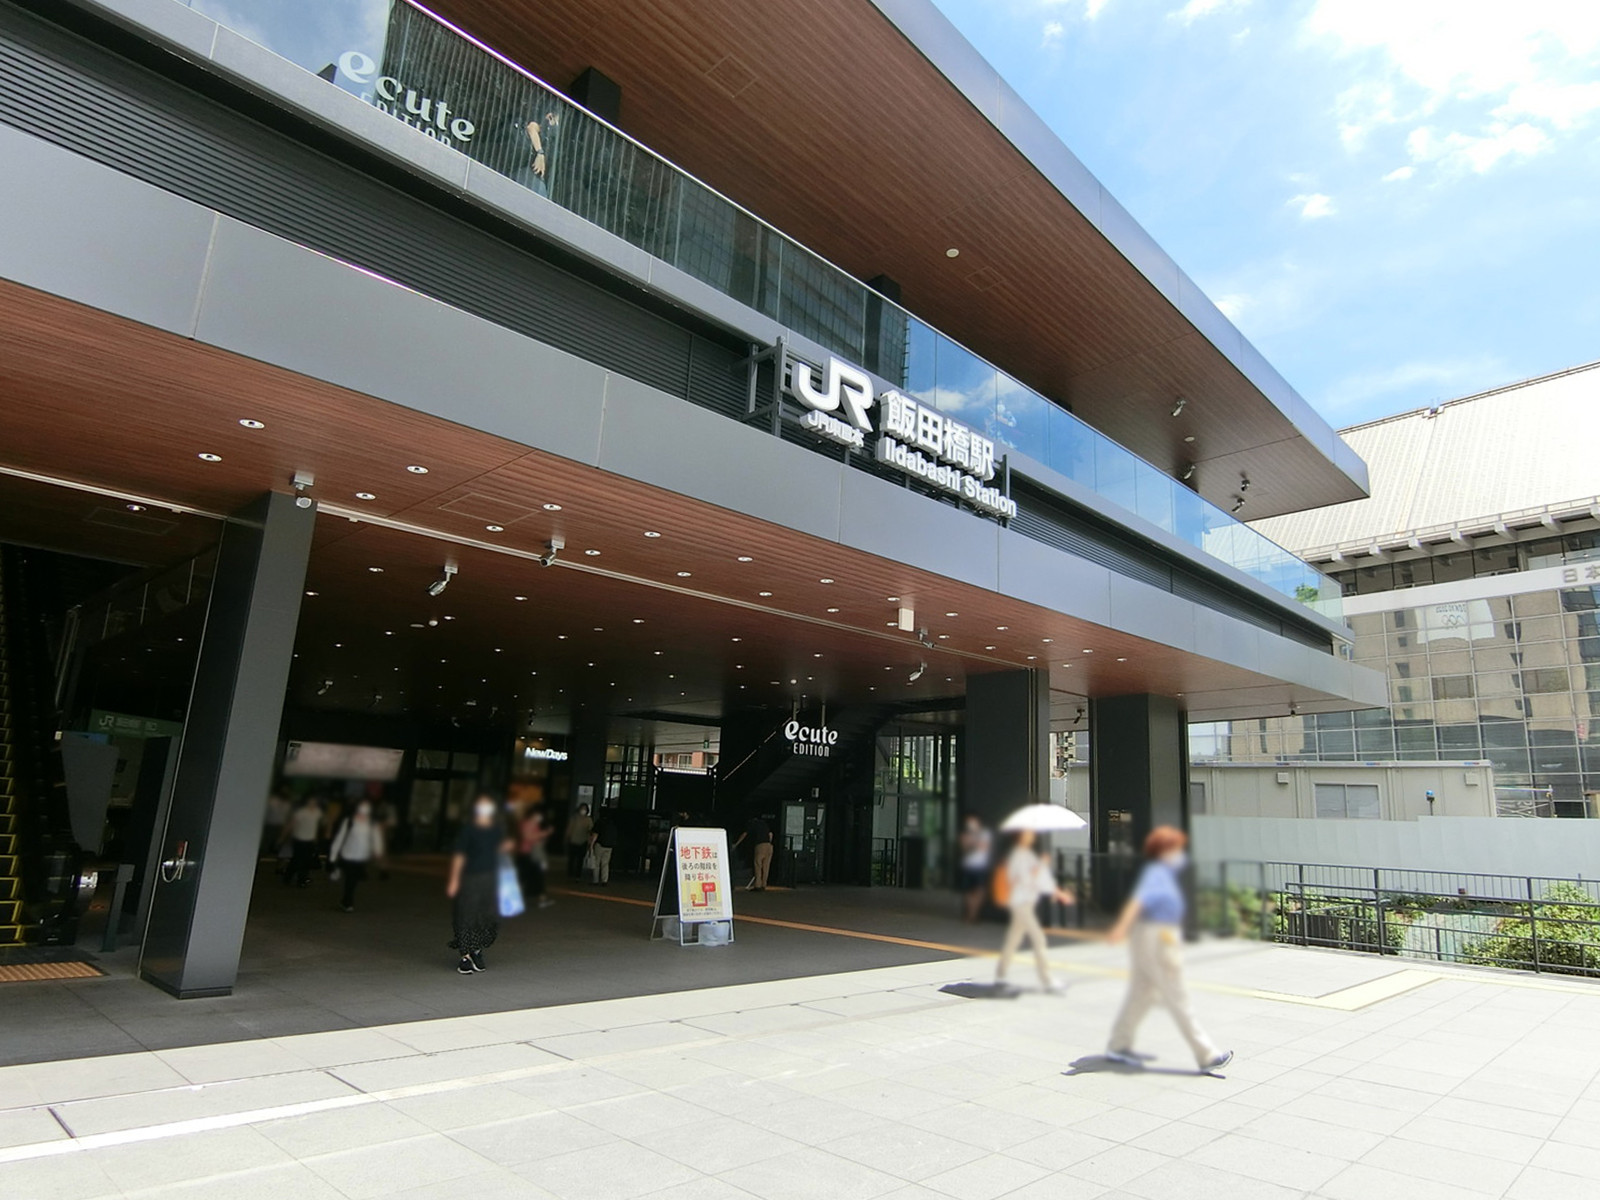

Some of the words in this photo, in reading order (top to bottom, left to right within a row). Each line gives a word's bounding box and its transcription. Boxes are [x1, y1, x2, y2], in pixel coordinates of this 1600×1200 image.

[338, 51, 475, 142] ecute
[795, 356, 874, 433] JR
[883, 389, 995, 480] 飯田橋駅
[882, 436, 961, 492] Iidabashi
[962, 475, 1017, 518] Station
[524, 747, 568, 760] NewDays
[785, 721, 838, 745] ecute
[793, 742, 830, 757] EDITION
[680, 846, 718, 860] 地下鉄は
